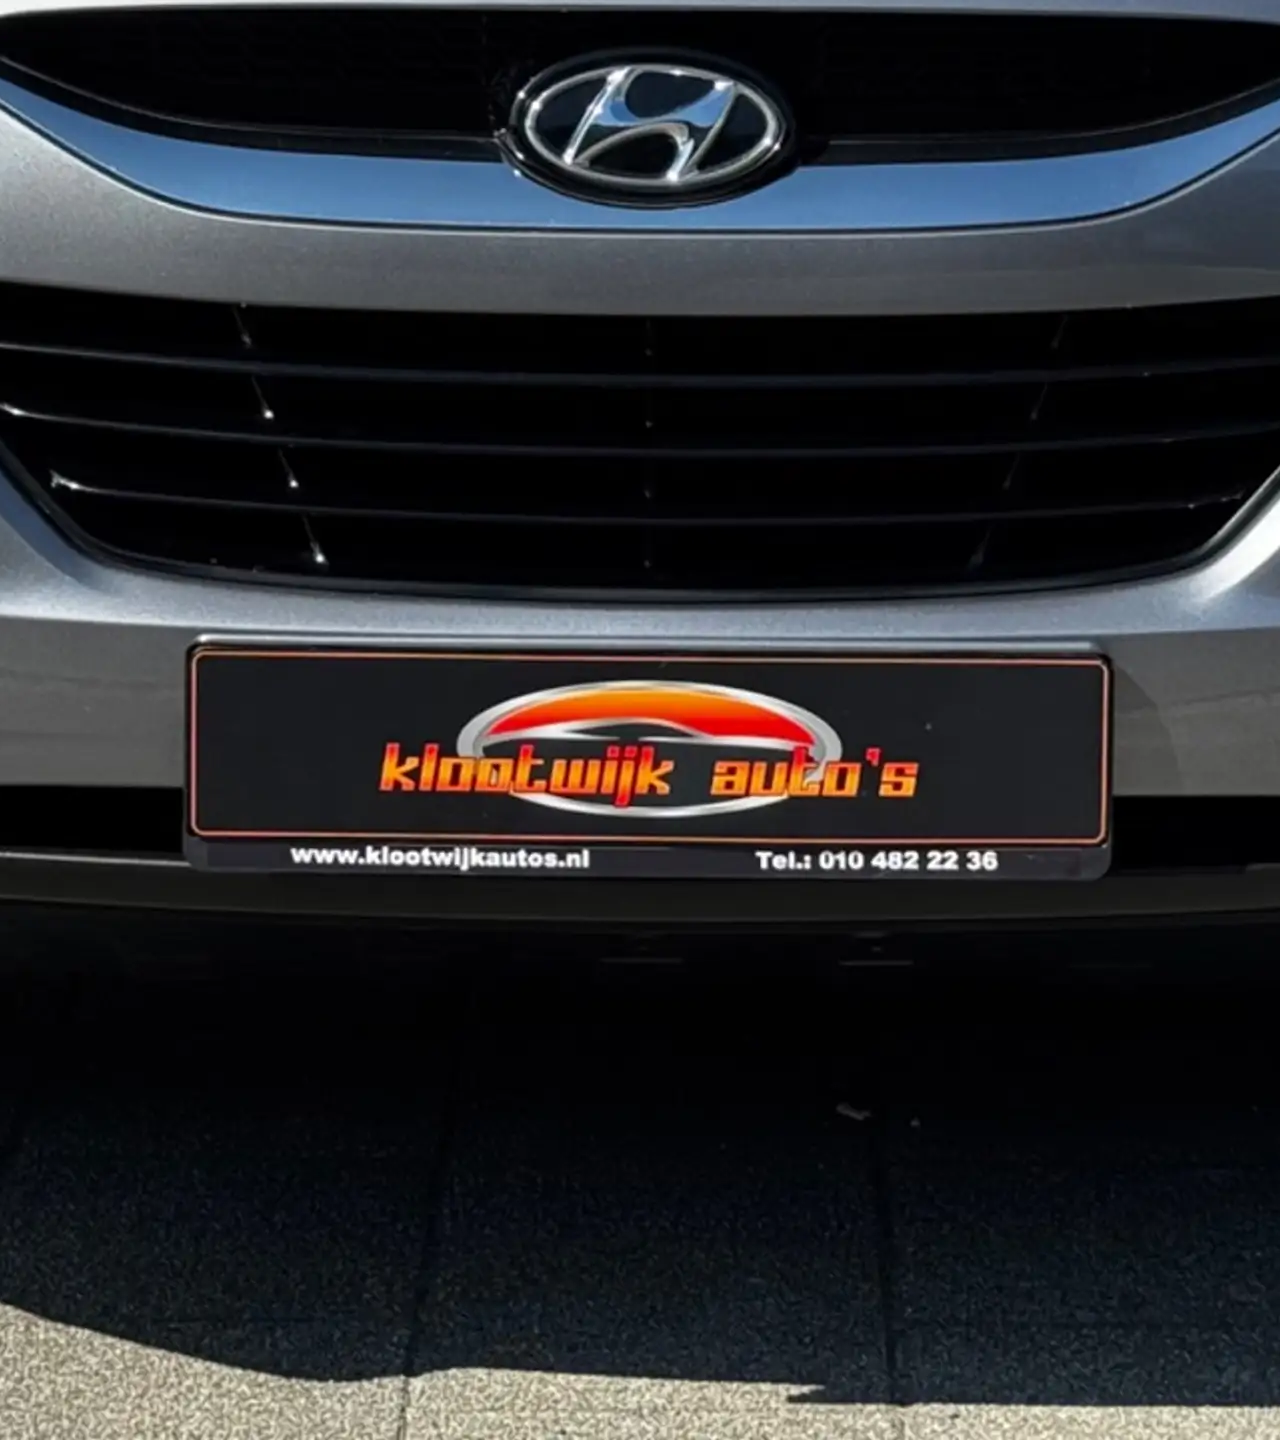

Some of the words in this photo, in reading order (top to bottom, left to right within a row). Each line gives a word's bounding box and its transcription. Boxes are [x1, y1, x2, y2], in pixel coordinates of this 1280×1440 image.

[379, 743, 674, 807] klootwijk
[711, 745, 919, 797] auto's
[290, 845, 590, 872] www.klootwijkautos.nl
[755, 850, 812, 871] Tel.:
[819, 850, 865, 871] 010
[870, 850, 920, 871] 482
[926, 850, 960, 871] 22
[966, 850, 999, 871] 36
